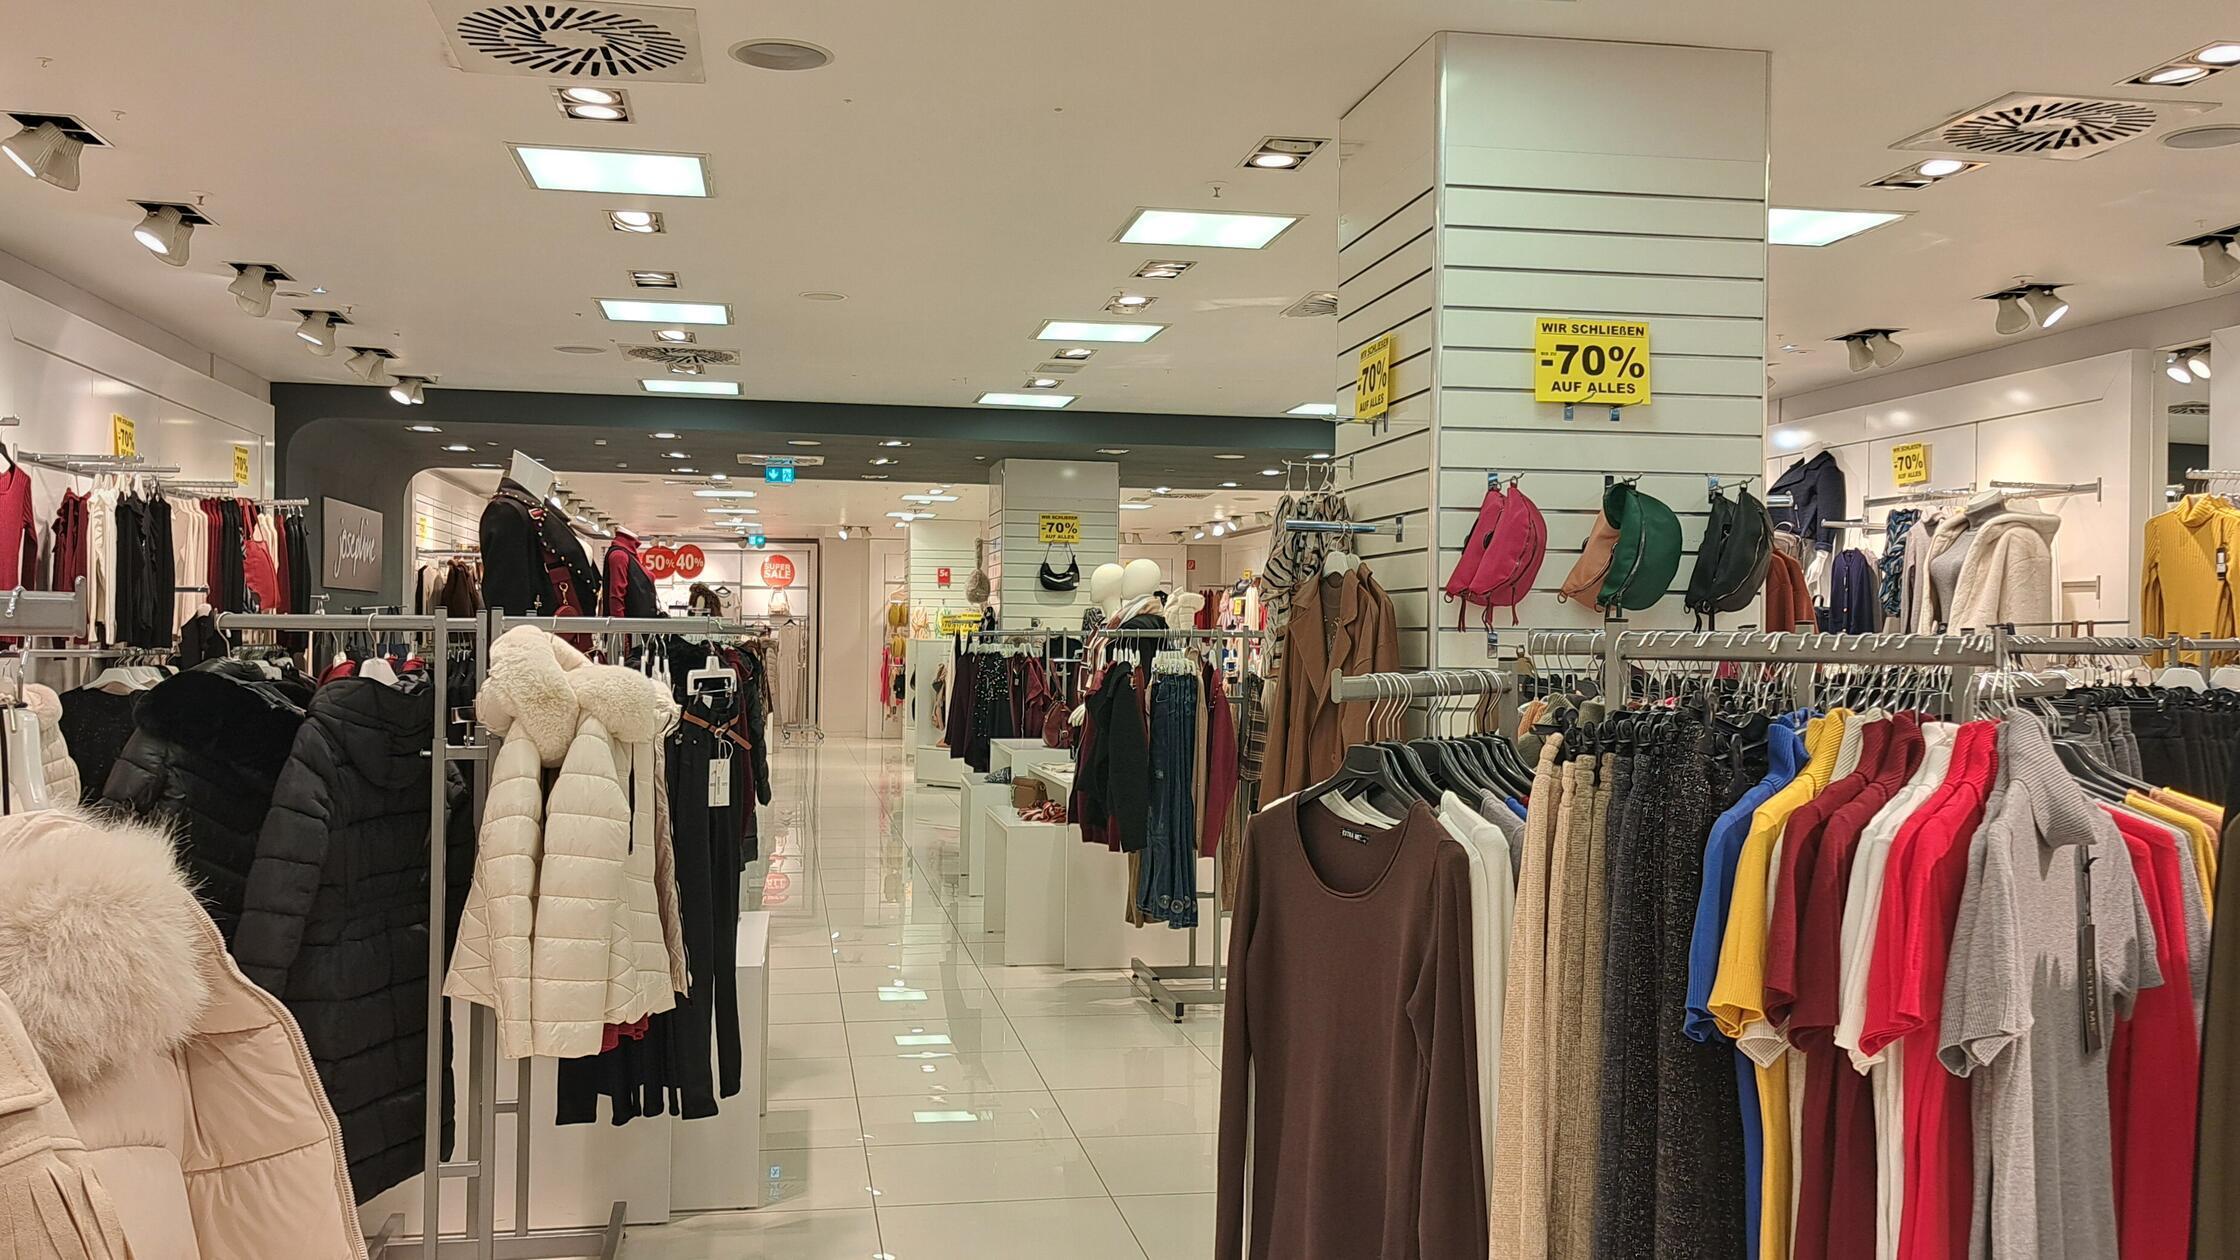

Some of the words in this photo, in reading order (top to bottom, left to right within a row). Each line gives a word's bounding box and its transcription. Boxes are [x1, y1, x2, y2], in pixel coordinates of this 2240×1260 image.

[1541, 322, 1567, 333] WIR
[1571, 324, 1645, 336] SCHLIEßEN
[1541, 344, 1645, 378] -70%
[1357, 356, 1387, 396] -70%
[1551, 381, 1582, 392] AUF
[1587, 382, 1636, 394] ALLES
[1359, 399, 1370, 413] AUF
[1370, 392, 1385, 408] ALLES
[1894, 452, 1923, 471] -70%
[1041, 522, 1078, 534] -70%
[676, 553, 704, 570] 40%
[765, 562, 791, 570] SUPER
[765, 569, 791, 579] SALE
